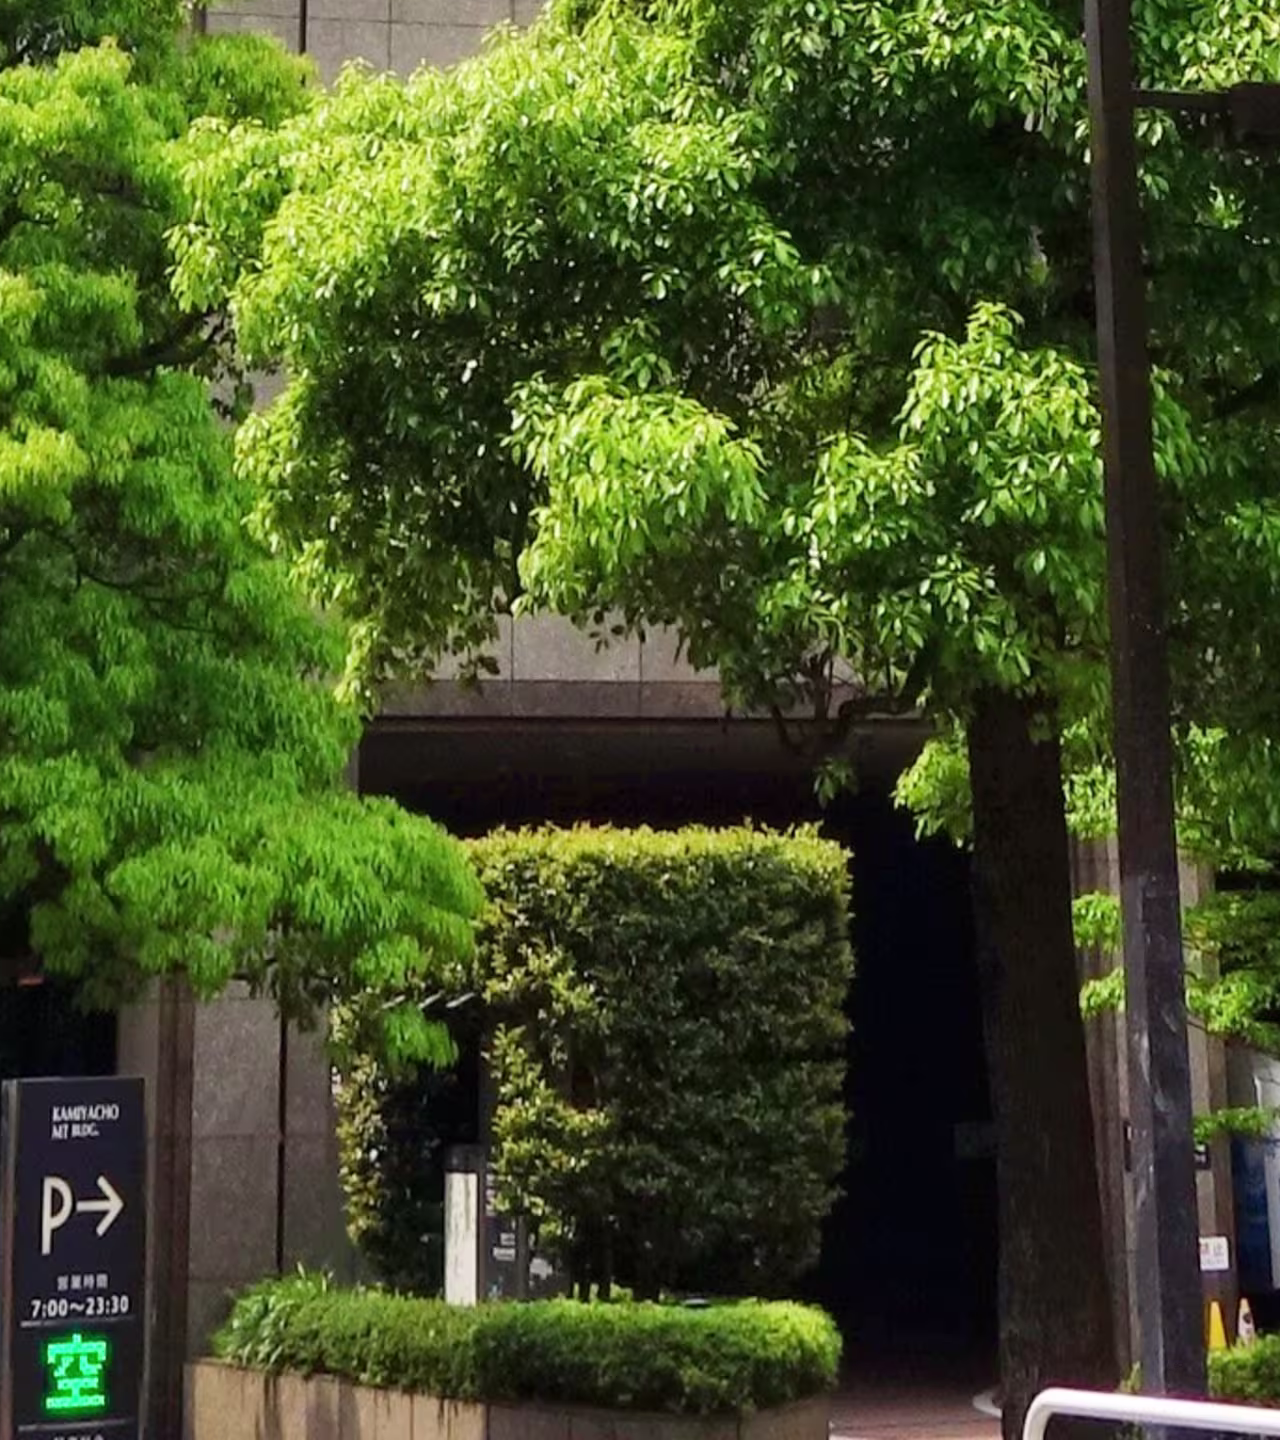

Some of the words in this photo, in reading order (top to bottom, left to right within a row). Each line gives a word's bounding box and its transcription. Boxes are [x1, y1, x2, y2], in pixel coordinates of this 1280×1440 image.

[52, 1103, 120, 1121] KAMIYACHO
[41, 1176, 72, 1256] P
[46, 1333, 107, 1410] 空
